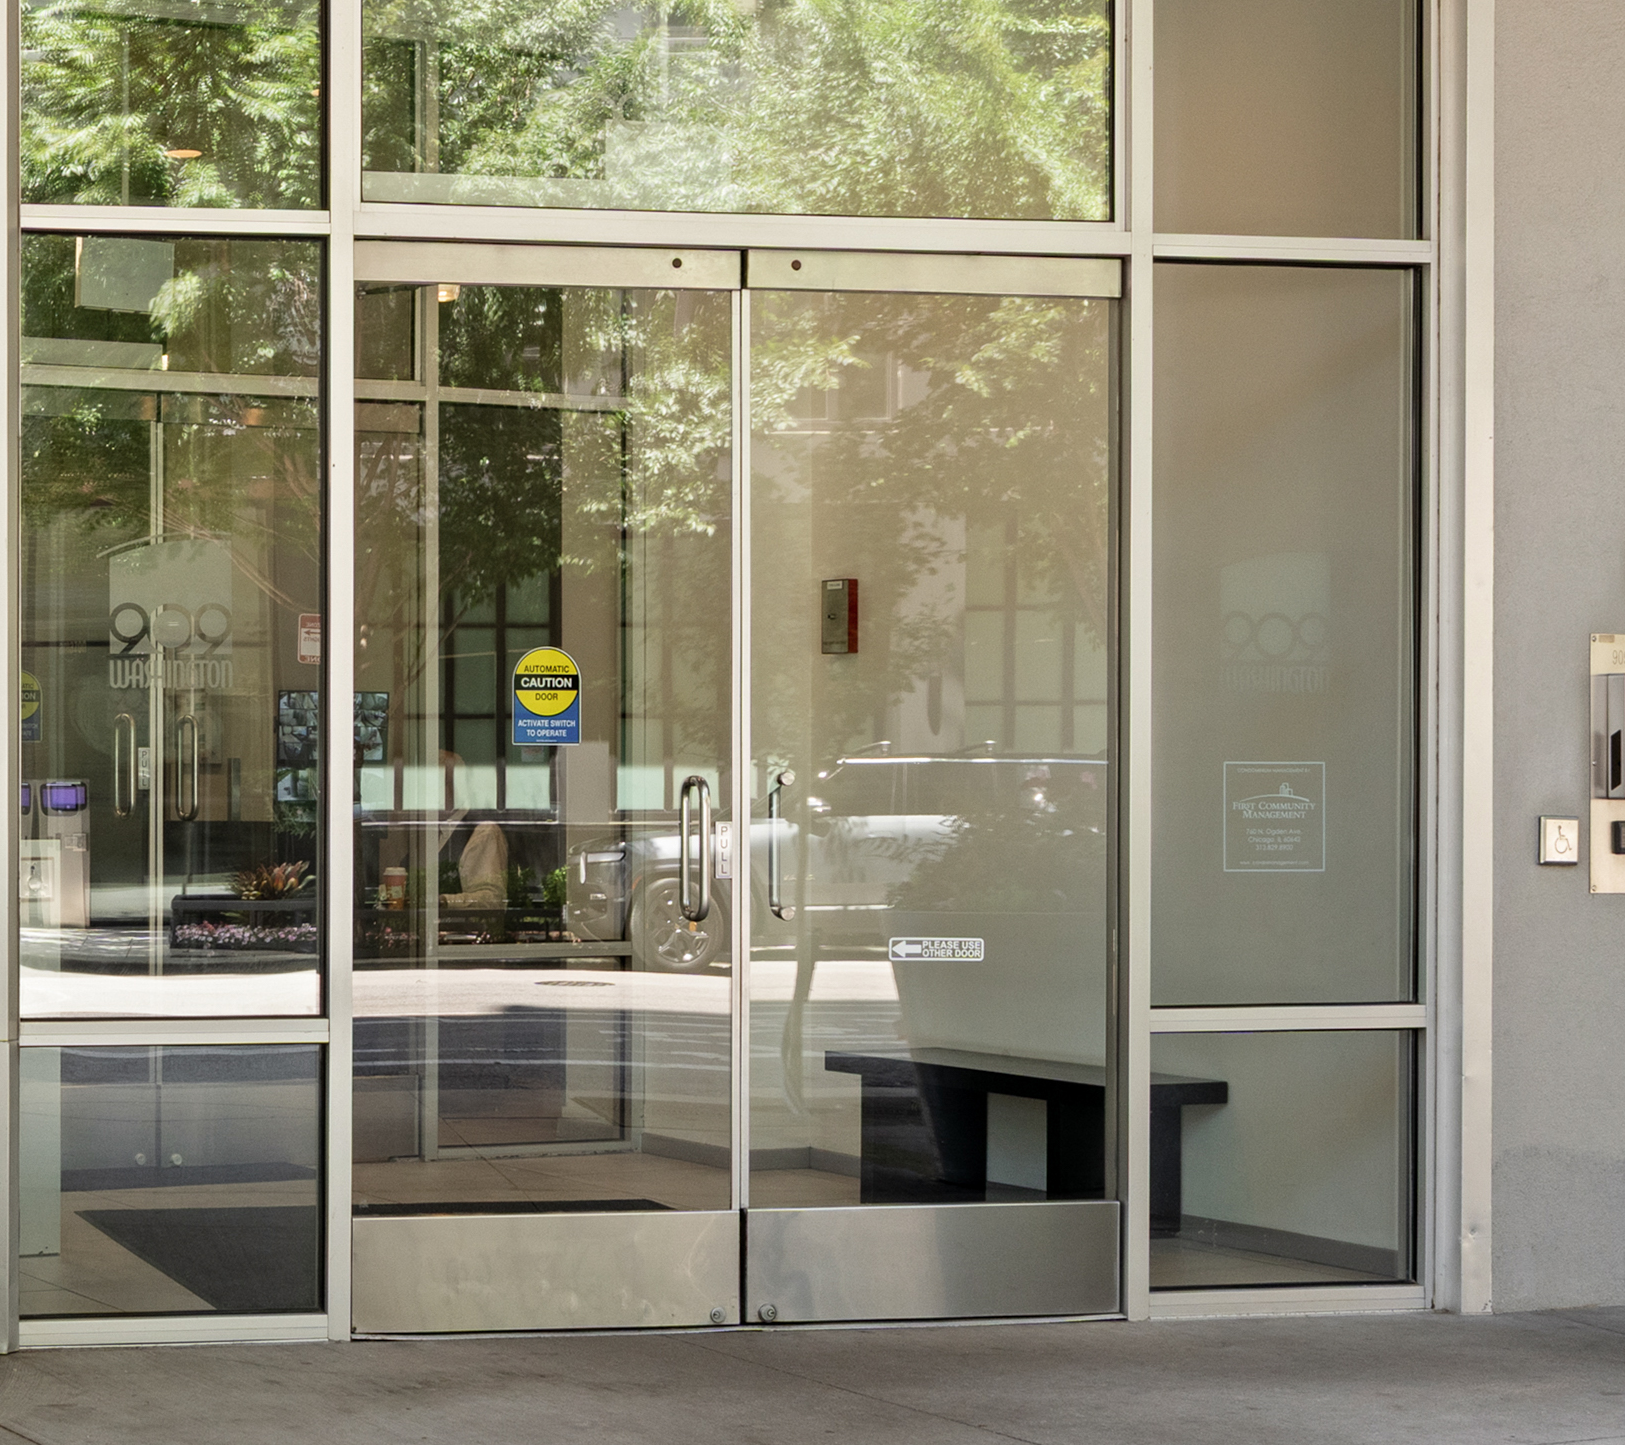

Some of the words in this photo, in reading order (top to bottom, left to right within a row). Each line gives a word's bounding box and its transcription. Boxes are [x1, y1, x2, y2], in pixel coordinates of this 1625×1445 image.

[523, 665, 570, 673] AUTOMATIC
[521, 677, 572, 688] CAUTION
[535, 693, 558, 701] DOOR
[518, 719, 549, 727] ACTIVATE
[550, 719, 576, 727] SWITCH
[536, 729, 567, 737] OPERATE
[1232, 801, 1256, 811] FIRST
[1258, 801, 1316, 810] COMMUNITY
[1242, 811, 1306, 819] MANAGEMENT
[720, 825, 728, 874] PULL
[922, 940, 960, 949] PLEASE
[961, 941, 981, 949] USE
[922, 949, 953, 957] OTHER
[954, 949, 981, 957] DOOR
